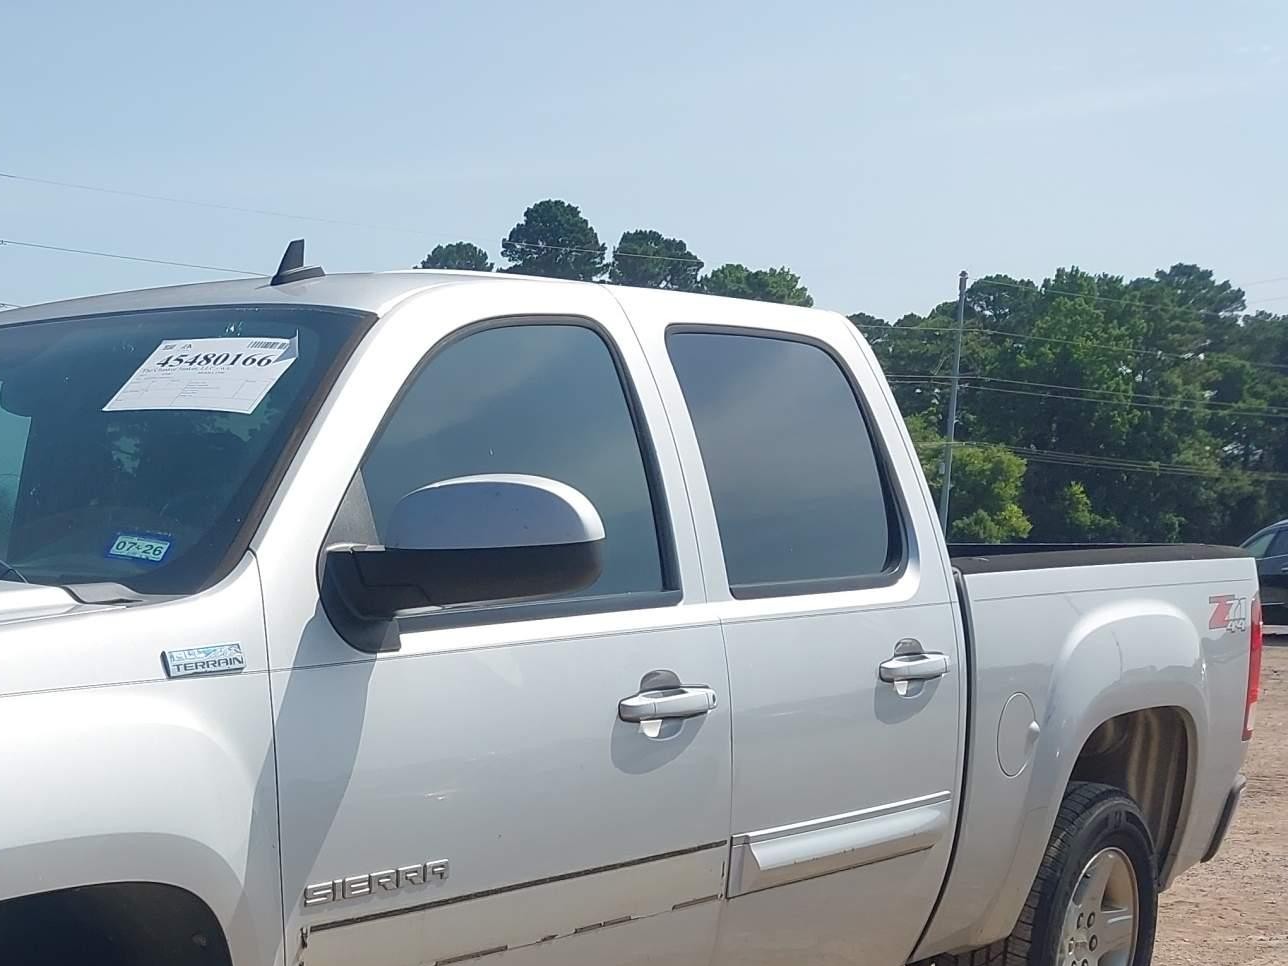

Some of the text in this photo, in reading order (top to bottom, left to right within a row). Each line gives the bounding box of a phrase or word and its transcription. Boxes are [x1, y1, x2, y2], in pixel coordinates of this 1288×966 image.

[156, 352, 276, 368] 45480166
[1208, 594, 1247, 630] Z71
[172, 655, 245, 673] TERRAIN
[304, 858, 449, 907] SIERRA
